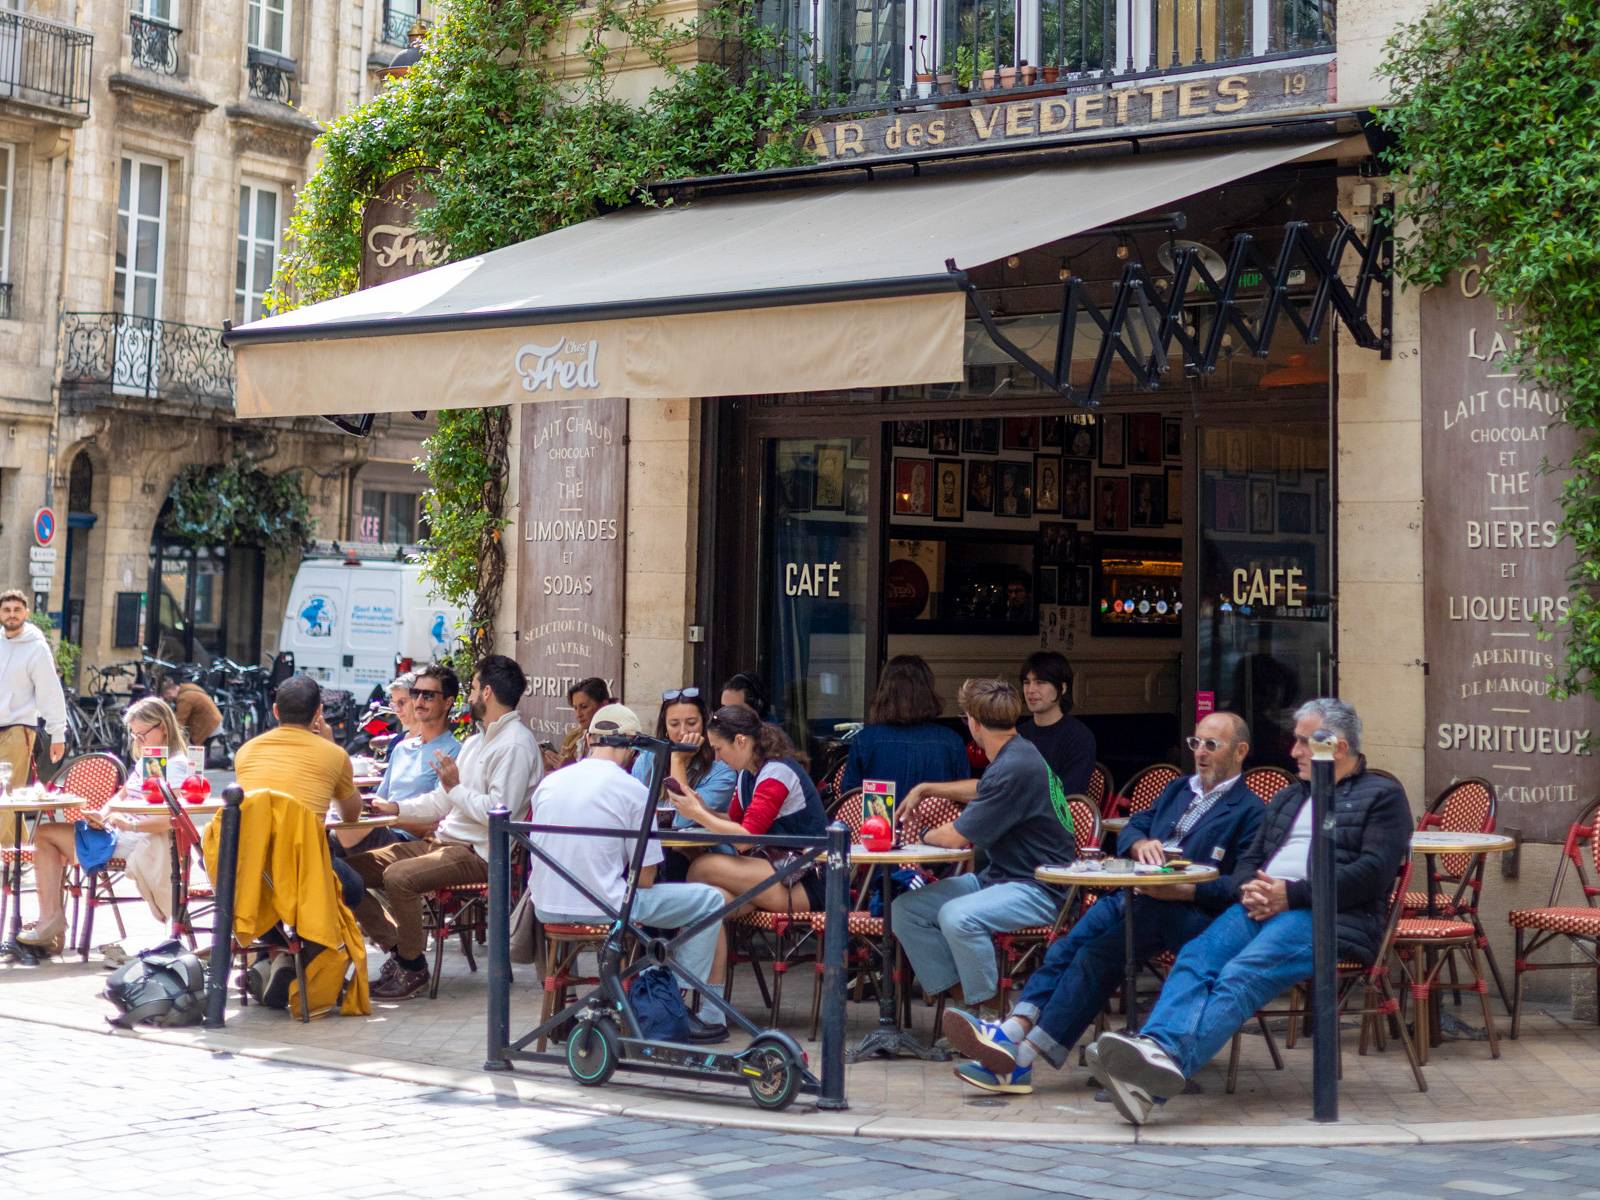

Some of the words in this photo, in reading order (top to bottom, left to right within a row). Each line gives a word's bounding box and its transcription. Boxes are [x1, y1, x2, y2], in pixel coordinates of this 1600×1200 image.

[802, 123, 865, 157] AR
[884, 118, 946, 150] des
[969, 76, 1250, 139] VEDETTES
[1282, 73, 1307, 97] 19
[515, 337, 598, 390] Fred
[1444, 391, 1489, 430] LAIT
[533, 419, 562, 449] LAIT
[566, 416, 613, 445] CHAUD
[1471, 426, 1548, 443] CHOCOLAT
[550, 446, 595, 460] CHOCOLAT
[1500, 451, 1517, 466] ET
[565, 465, 576, 478] ET
[1487, 471, 1530, 495] THE
[525, 519, 618, 542] LIMONADES
[1466, 520, 1557, 549] BIERES
[563, 551, 573, 565] ET
[785, 561, 841, 597] CAFÉ
[1501, 563, 1517, 578] ET
[544, 575, 592, 595] SODAS
[1233, 566, 1302, 606] CAFÉ
[1449, 596, 1571, 622] LIQUEURS
[524, 619, 576, 645] SELECTION
[545, 641, 558, 656] AU
[1472, 648, 1554, 669] APERITIFS
[1461, 682, 1480, 699] DE
[1438, 723, 1591, 756] SPIRITUEUX
